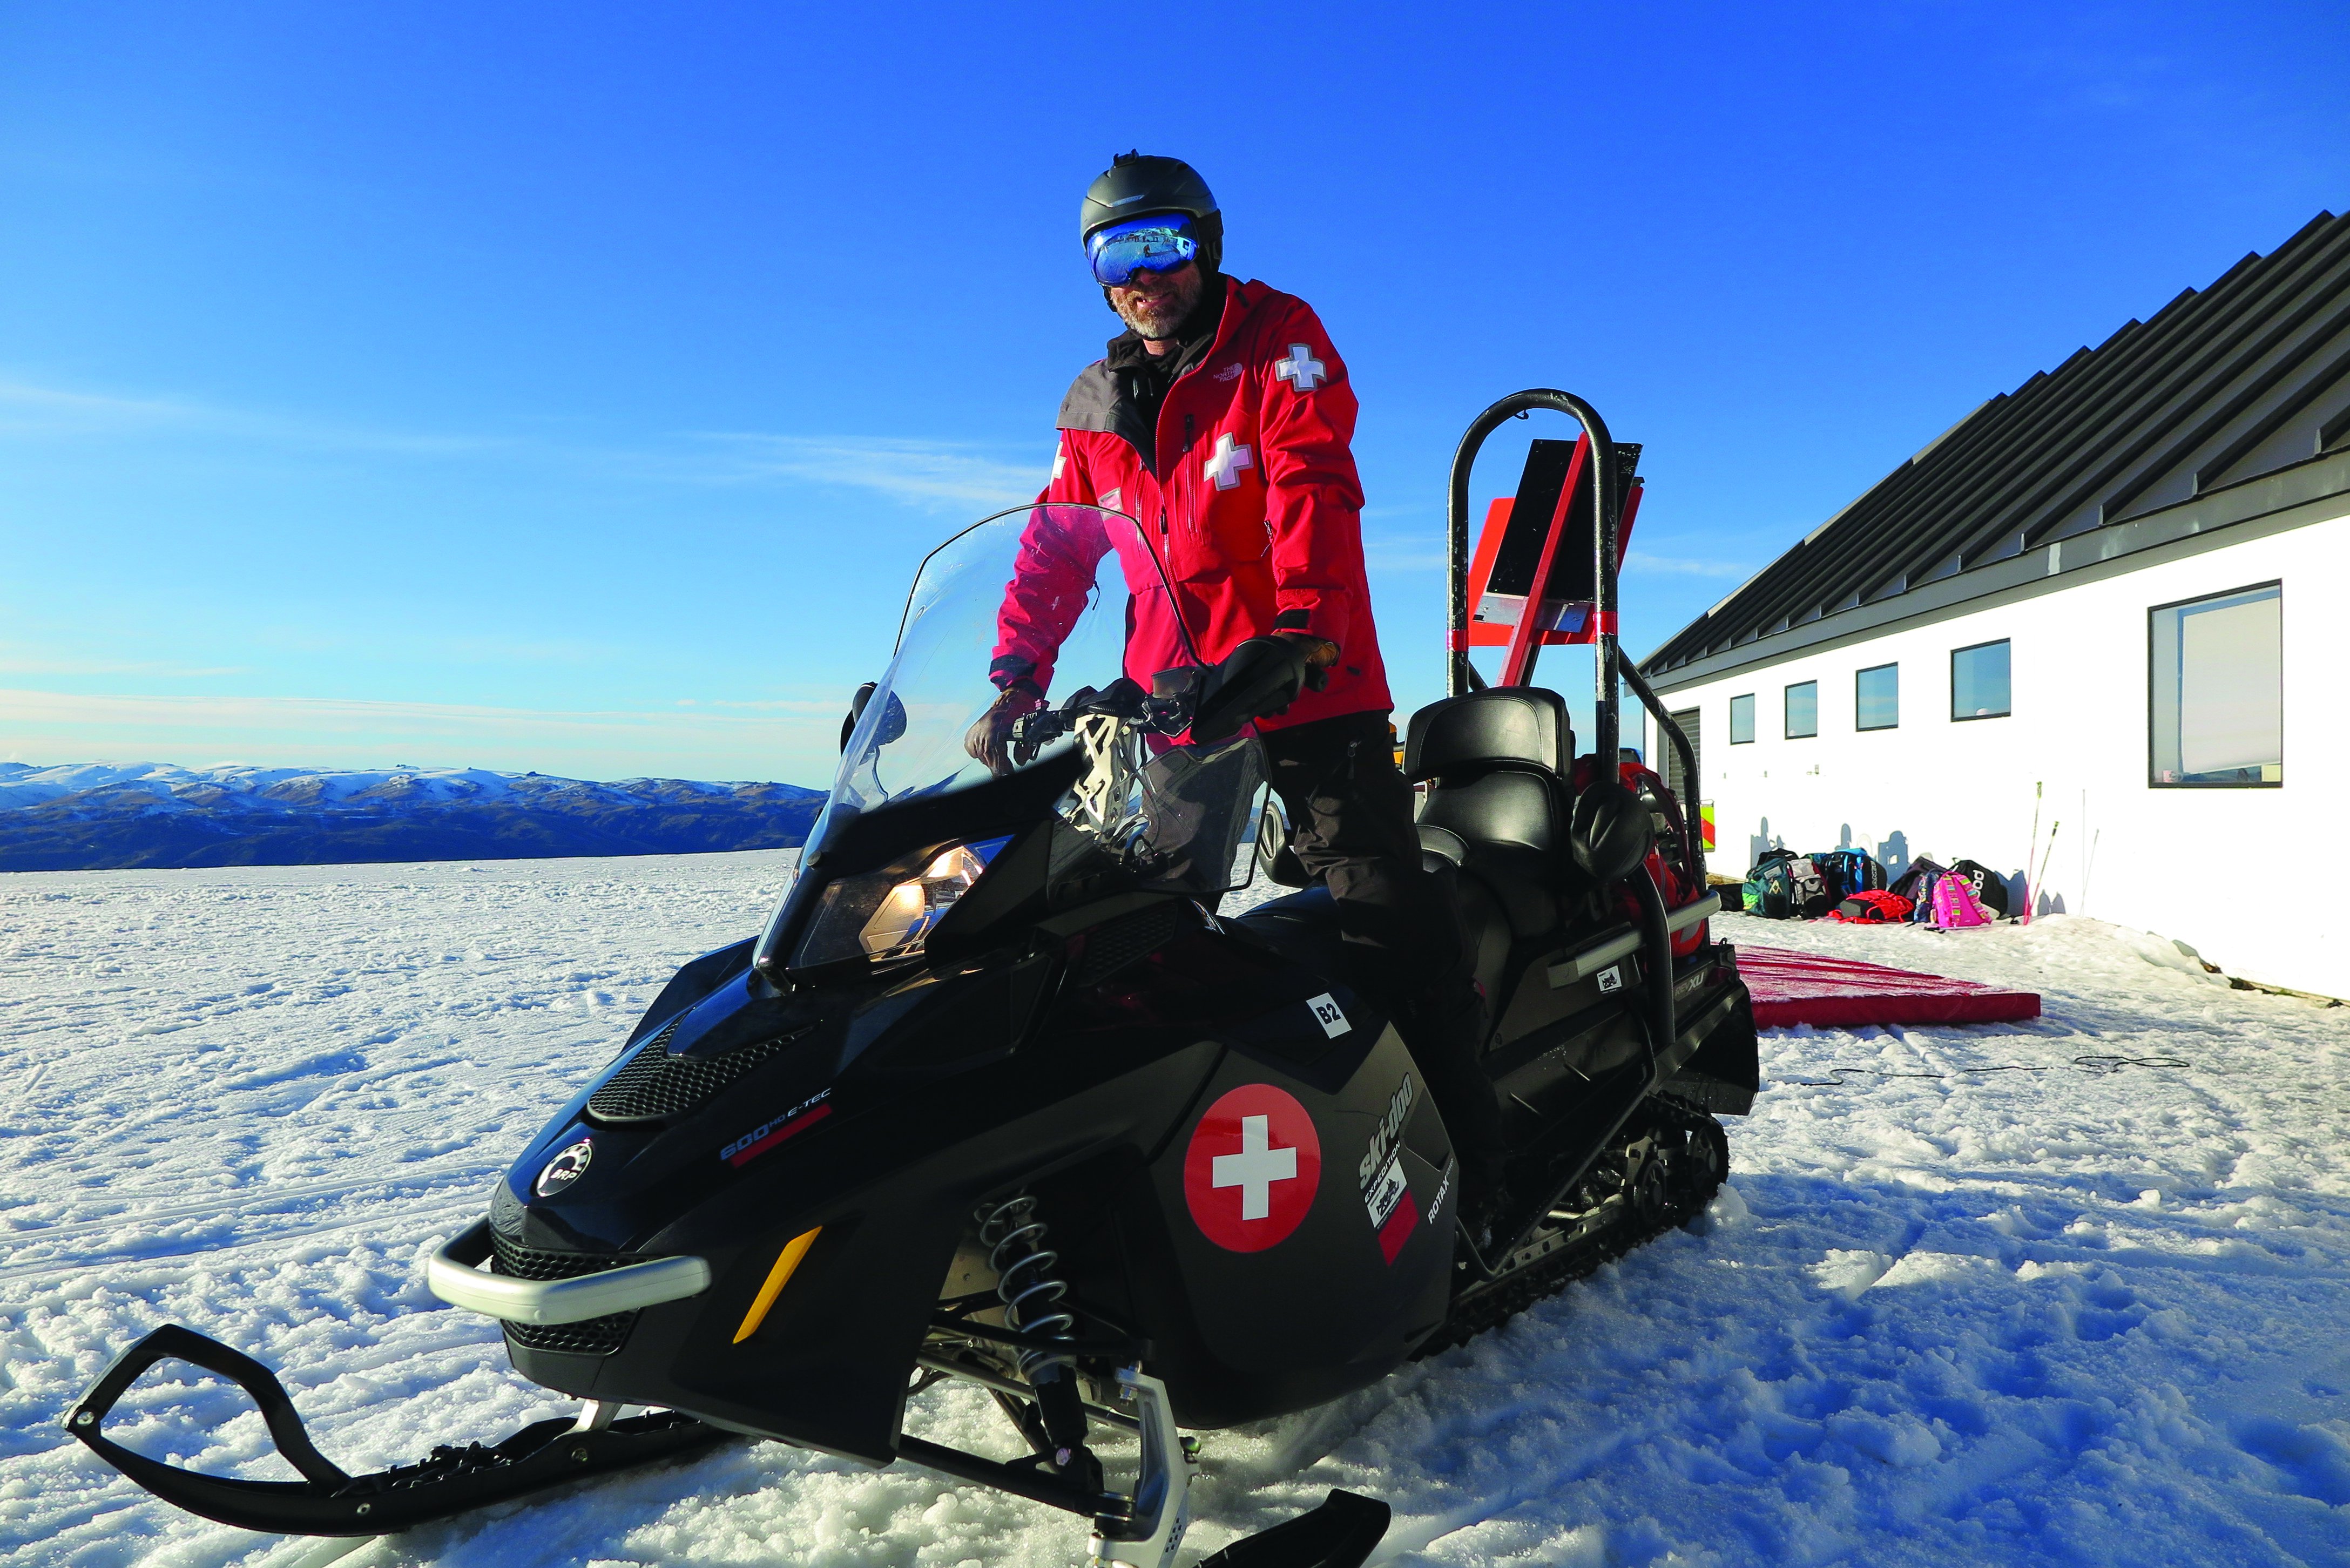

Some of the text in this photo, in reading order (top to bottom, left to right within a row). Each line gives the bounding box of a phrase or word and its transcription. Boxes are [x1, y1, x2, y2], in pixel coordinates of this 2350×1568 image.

[1213, 370, 1234, 380] NORTH
[1219, 374, 1235, 383] FACE
[1315, 1003, 1341, 1025] B2
[787, 1087, 832, 1117] E-TEC
[550, 1168, 578, 1181] BRP
[1364, 1140, 1401, 1204] EXPEDITION
[1428, 1174, 1451, 1225] ROTAX
